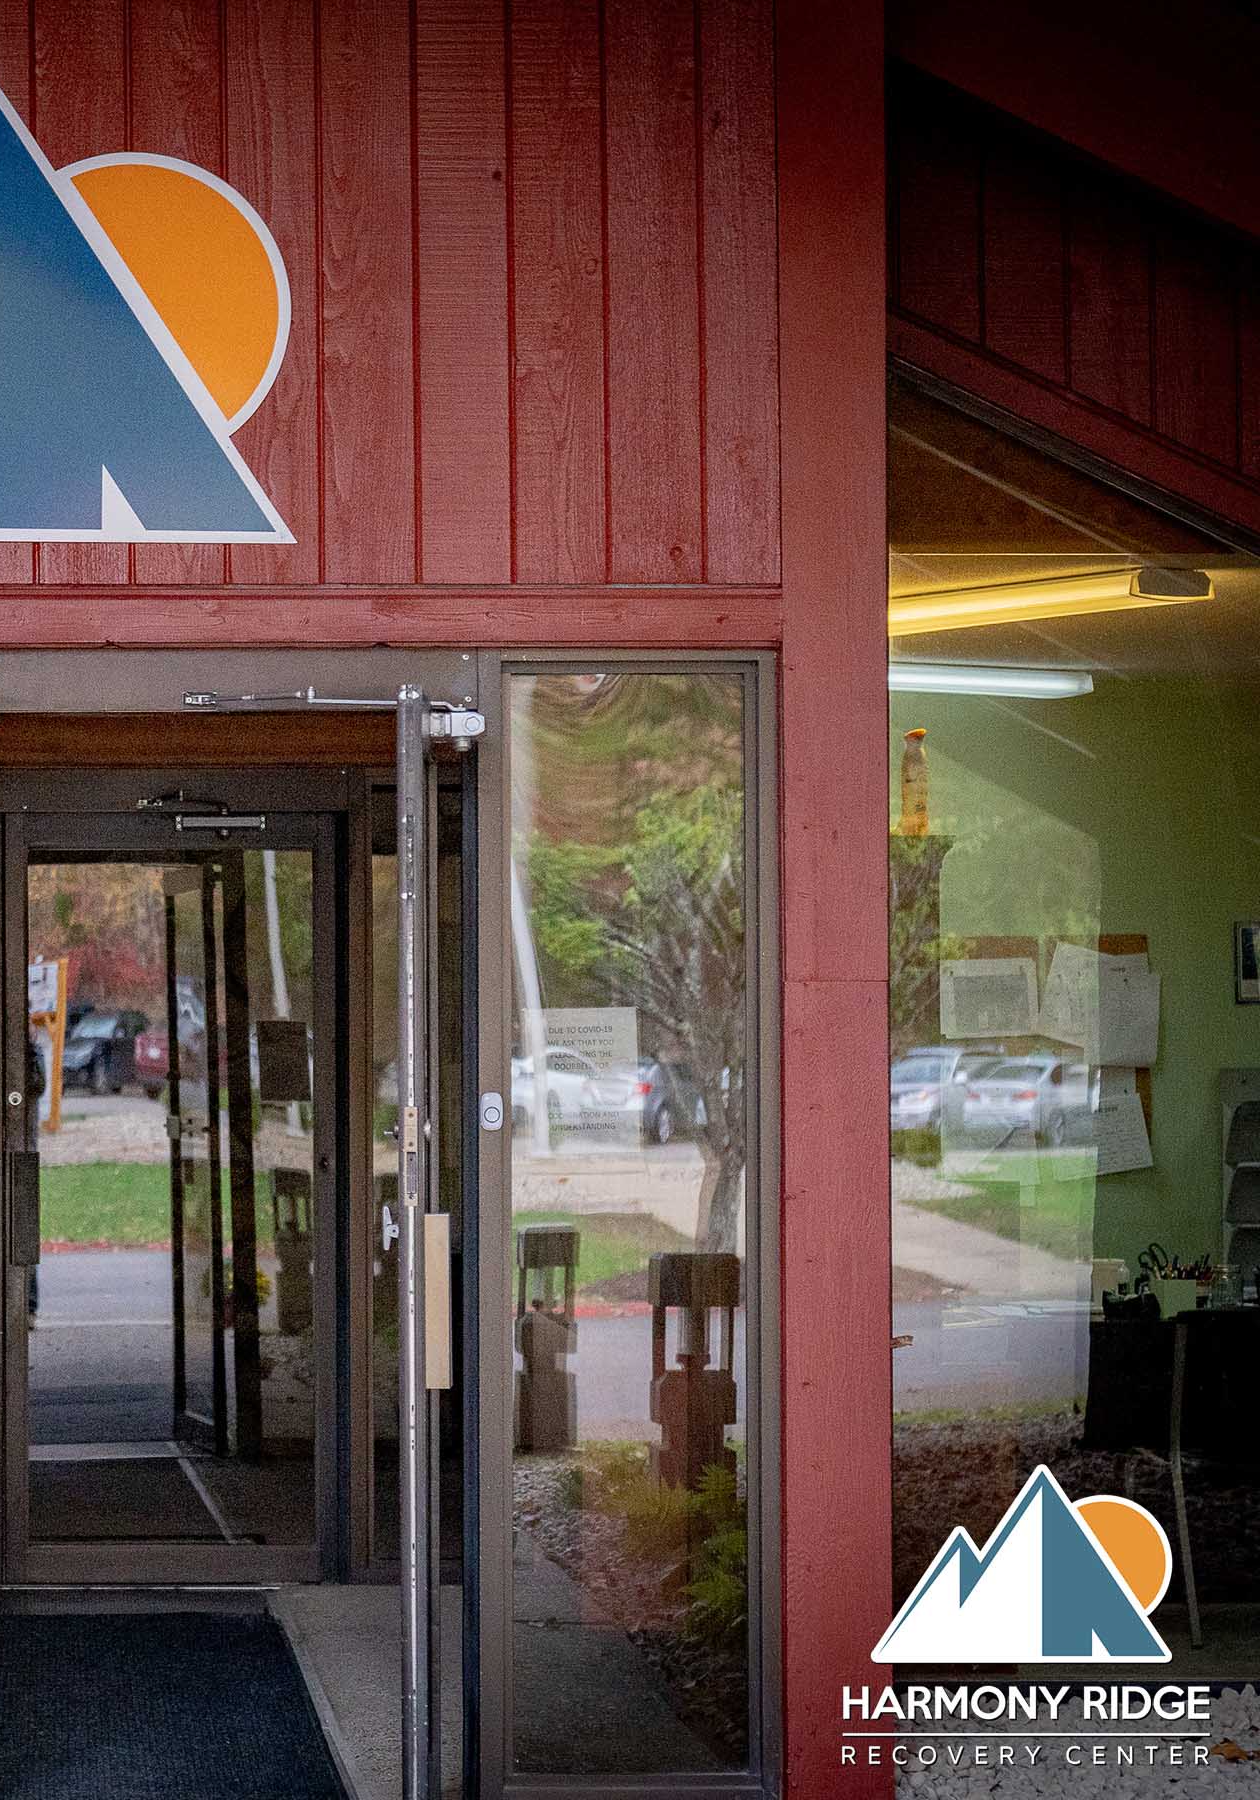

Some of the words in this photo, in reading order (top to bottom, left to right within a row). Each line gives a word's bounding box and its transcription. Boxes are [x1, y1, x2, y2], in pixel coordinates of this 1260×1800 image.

[548, 1026, 564, 1034] DUE
[567, 1026, 576, 1034] TO
[578, 1025, 613, 1034] COVID-19
[578, 1039, 597, 1047] THAT
[599, 1039, 614, 1047] YOU
